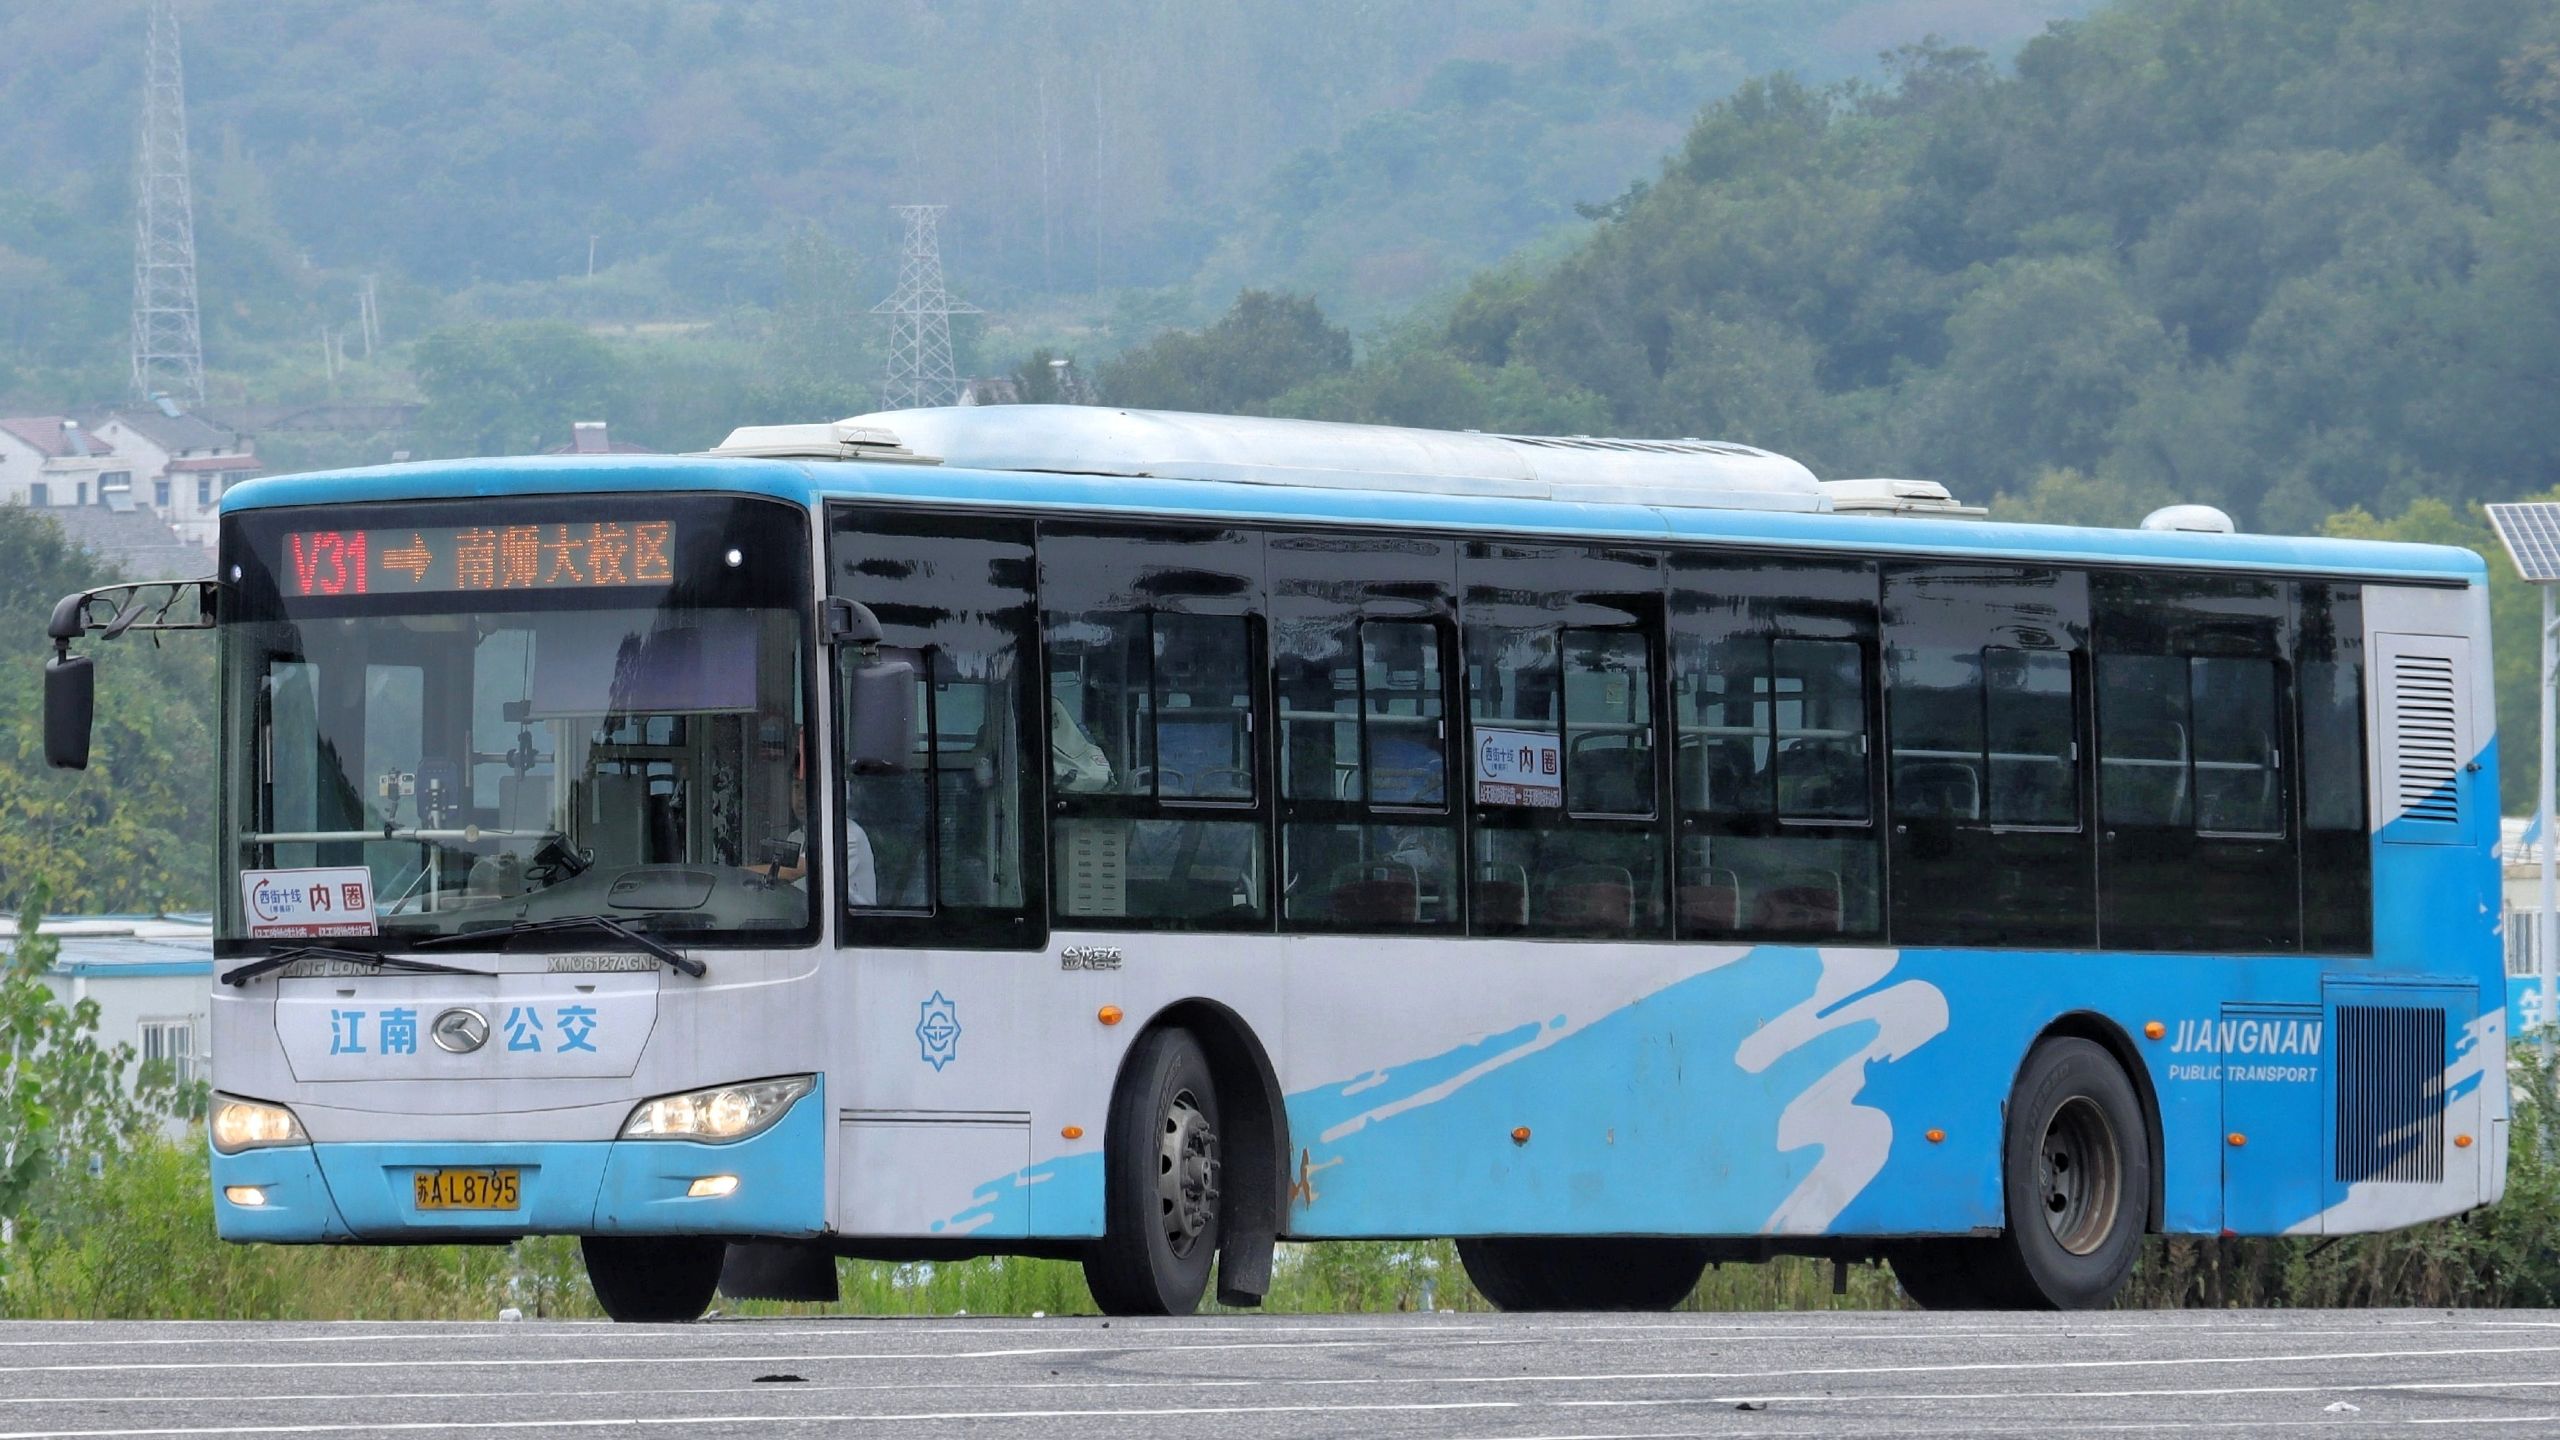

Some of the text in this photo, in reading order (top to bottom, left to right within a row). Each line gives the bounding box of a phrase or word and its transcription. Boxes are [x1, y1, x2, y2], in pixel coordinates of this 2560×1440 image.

[293, 529, 367, 595] V31
[456, 521, 674, 590] 南师大校区
[1519, 745, 1557, 775] 内圈
[309, 883, 365, 912] 内圈
[1061, 945, 1122, 970] 金龙客车
[329, 1005, 598, 1056] 江南 公交
[2170, 1019, 2323, 1055] JIANGNAN
[2169, 1064, 2318, 1082] PUBLIC TRANSPORT
